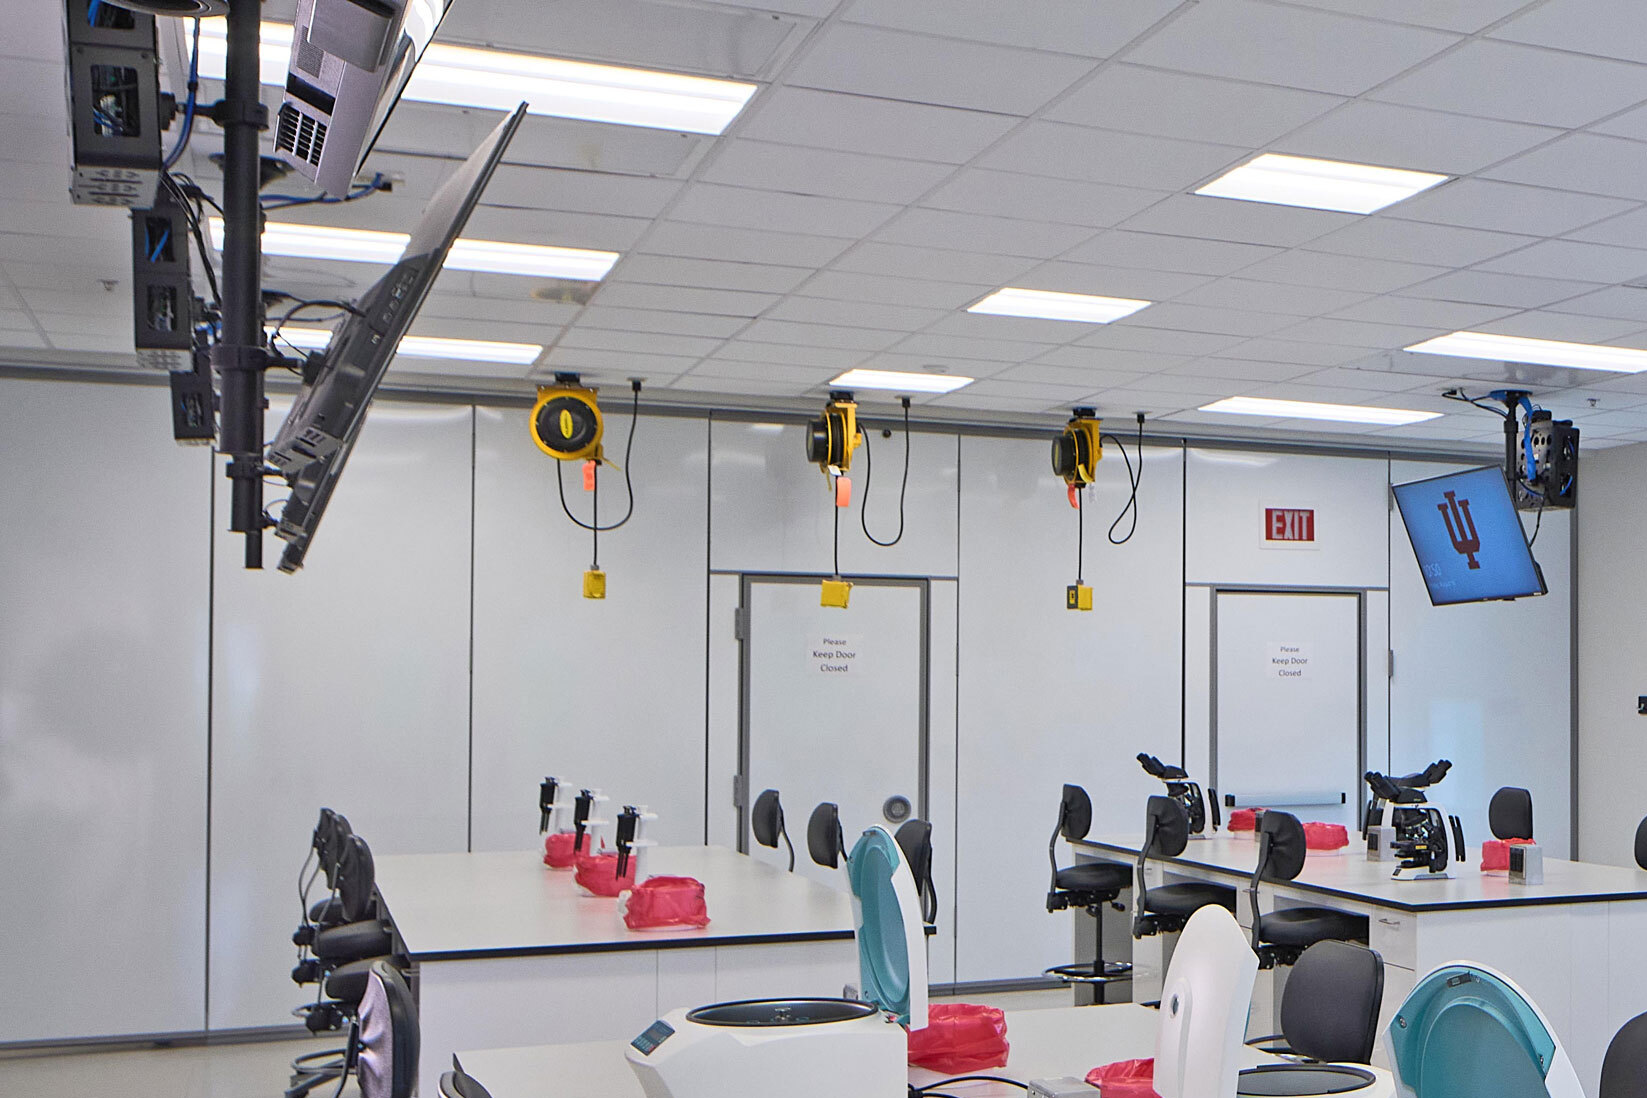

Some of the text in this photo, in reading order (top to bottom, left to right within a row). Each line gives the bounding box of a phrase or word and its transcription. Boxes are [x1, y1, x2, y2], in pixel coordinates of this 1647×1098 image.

[1272, 510, 1310, 540] EXIT
[823, 638, 847, 646] Please
[812, 650, 856, 660] Keep Door
[1272, 657, 1290, 665] Keep
[820, 664, 849, 673] Closed
[1278, 669, 1302, 677] Closed
